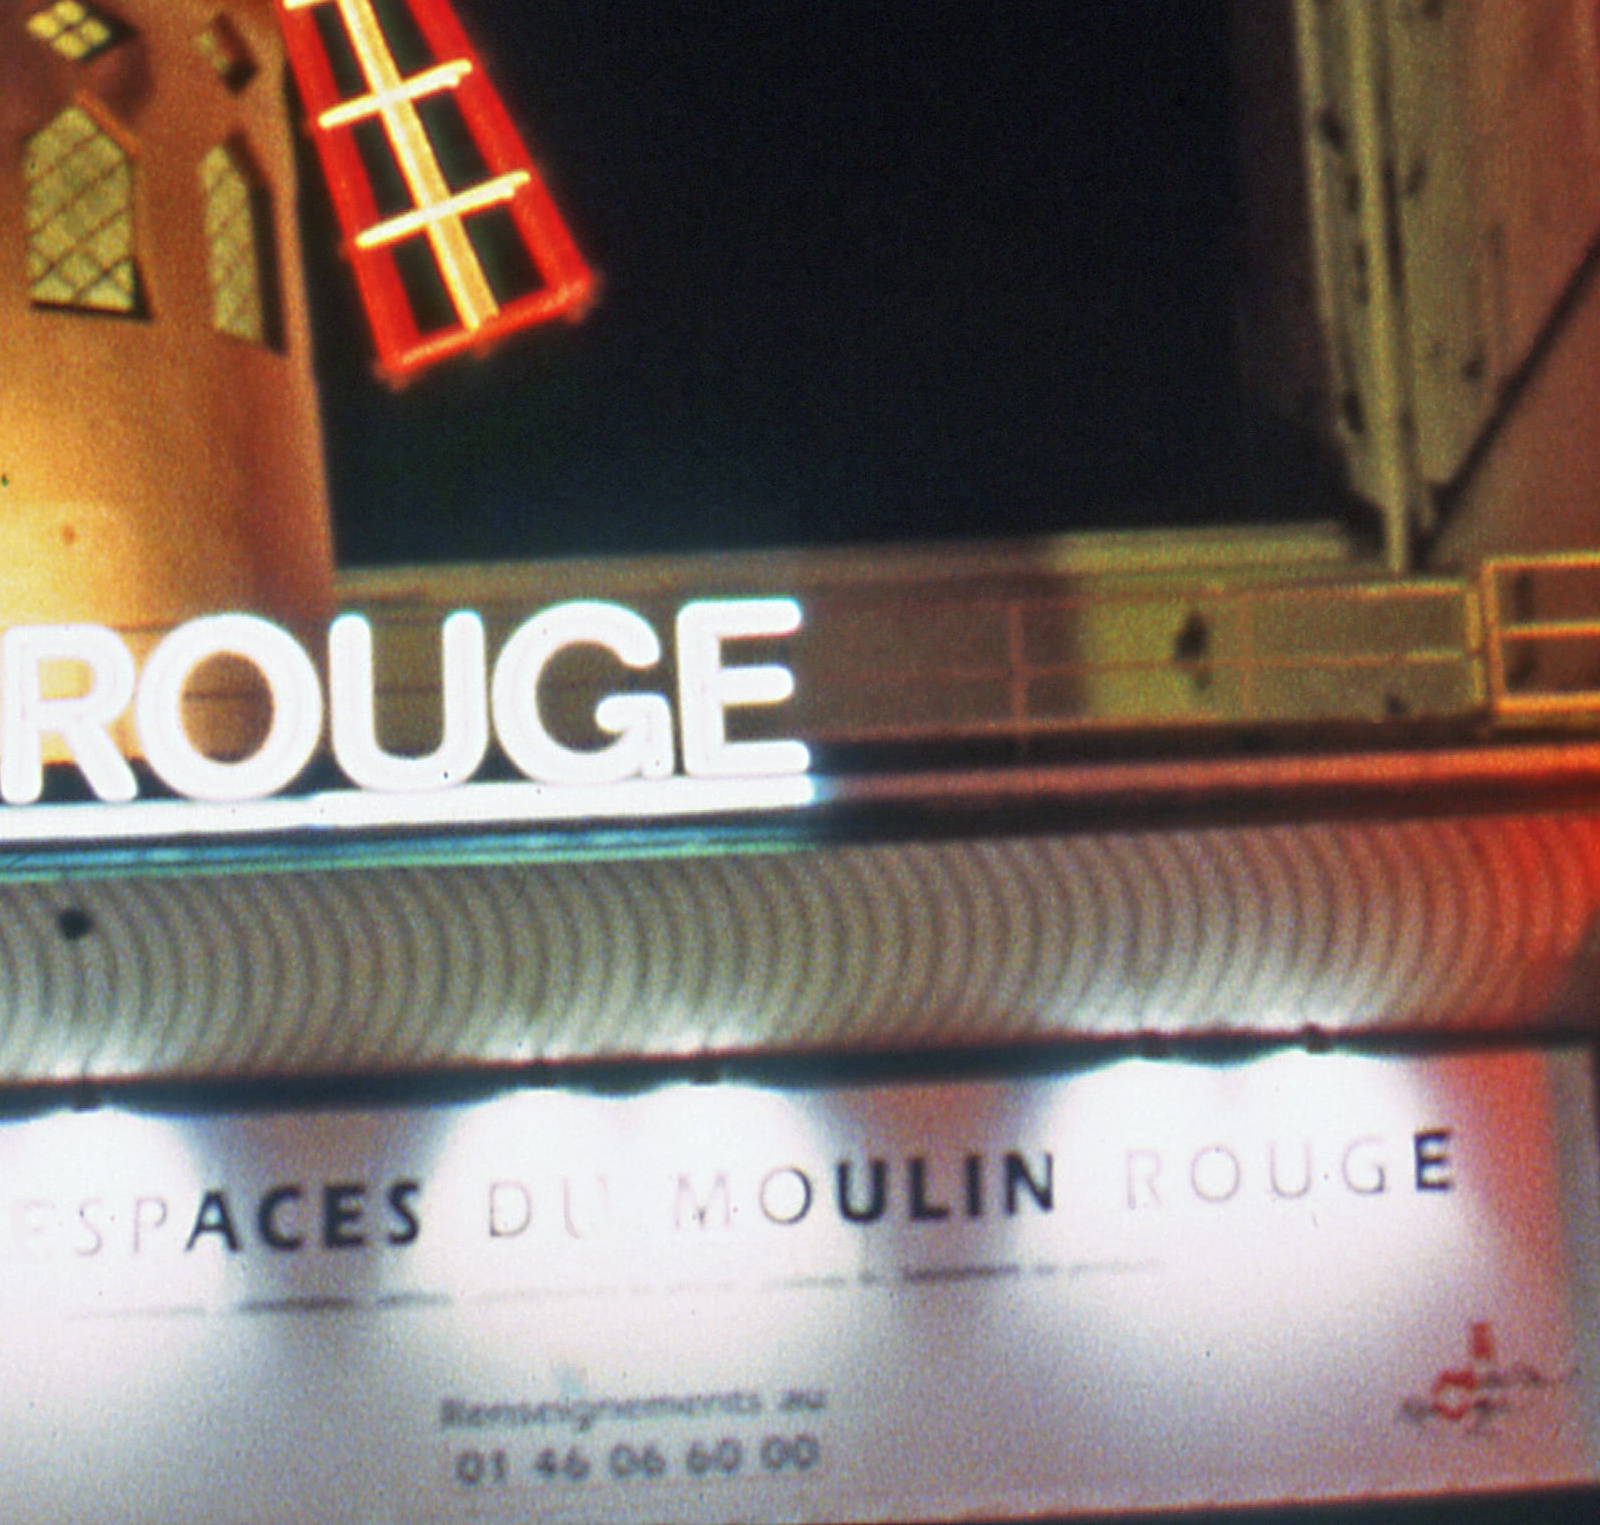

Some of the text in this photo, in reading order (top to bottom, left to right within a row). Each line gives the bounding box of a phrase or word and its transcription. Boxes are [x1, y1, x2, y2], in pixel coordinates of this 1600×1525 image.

[11, 1179, 421, 1264] ESPACES
[674, 1152, 1055, 1233] MOULIN
[1124, 1128, 1455, 1210] ROUGE
[440, 1388, 826, 1434] Renseignements au
[456, 1431, 821, 1486] 01 46 06 60 00
